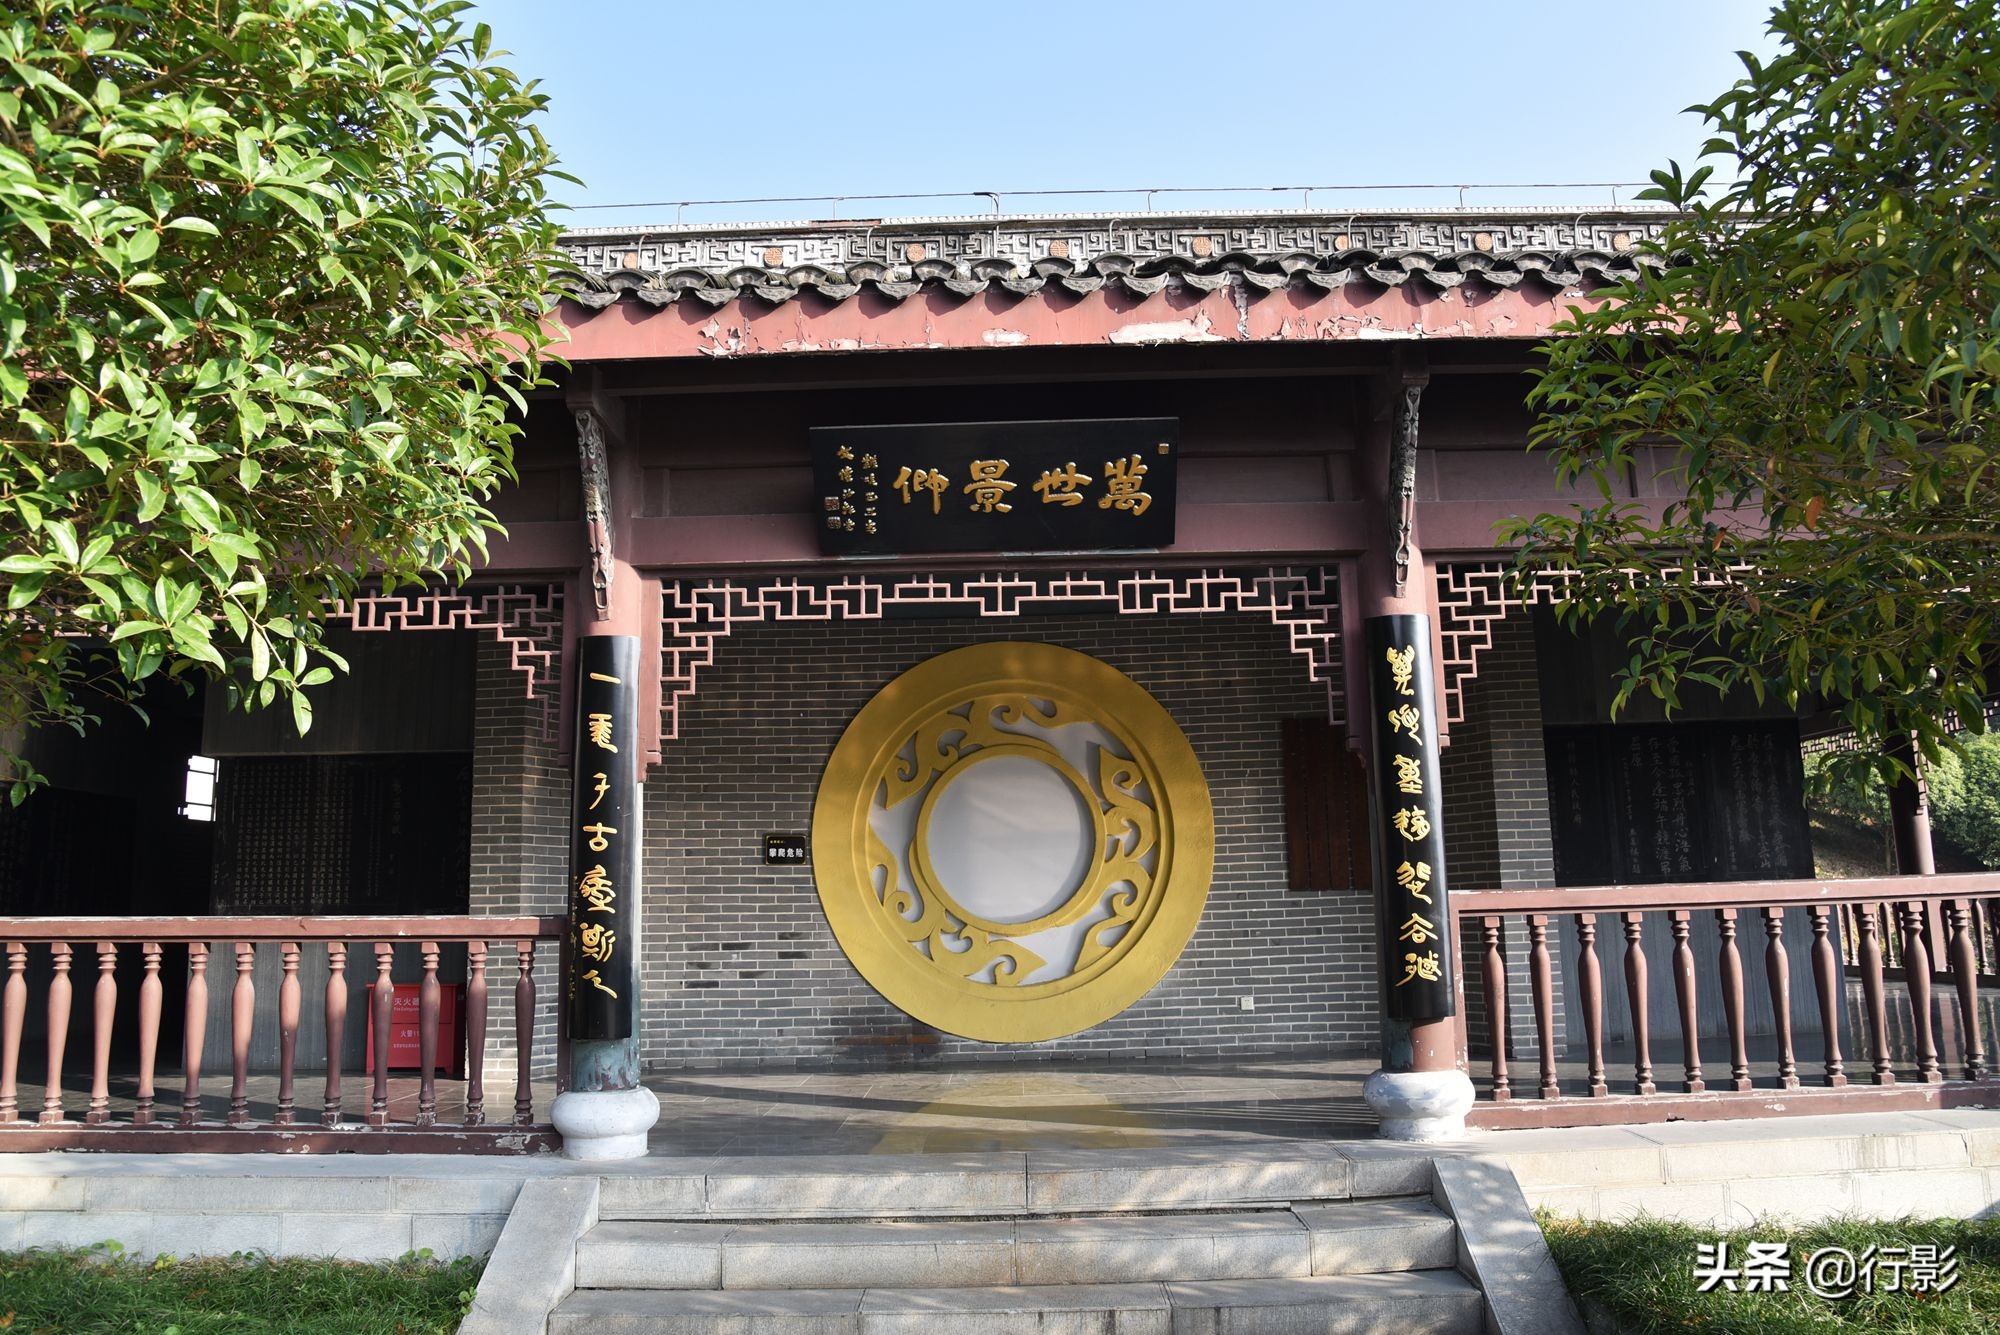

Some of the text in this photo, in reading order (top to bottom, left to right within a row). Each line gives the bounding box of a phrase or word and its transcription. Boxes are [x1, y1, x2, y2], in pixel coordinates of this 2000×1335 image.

[892, 454, 1152, 516] 萬世景仰
[769, 848, 803, 857] 攀爬危险
